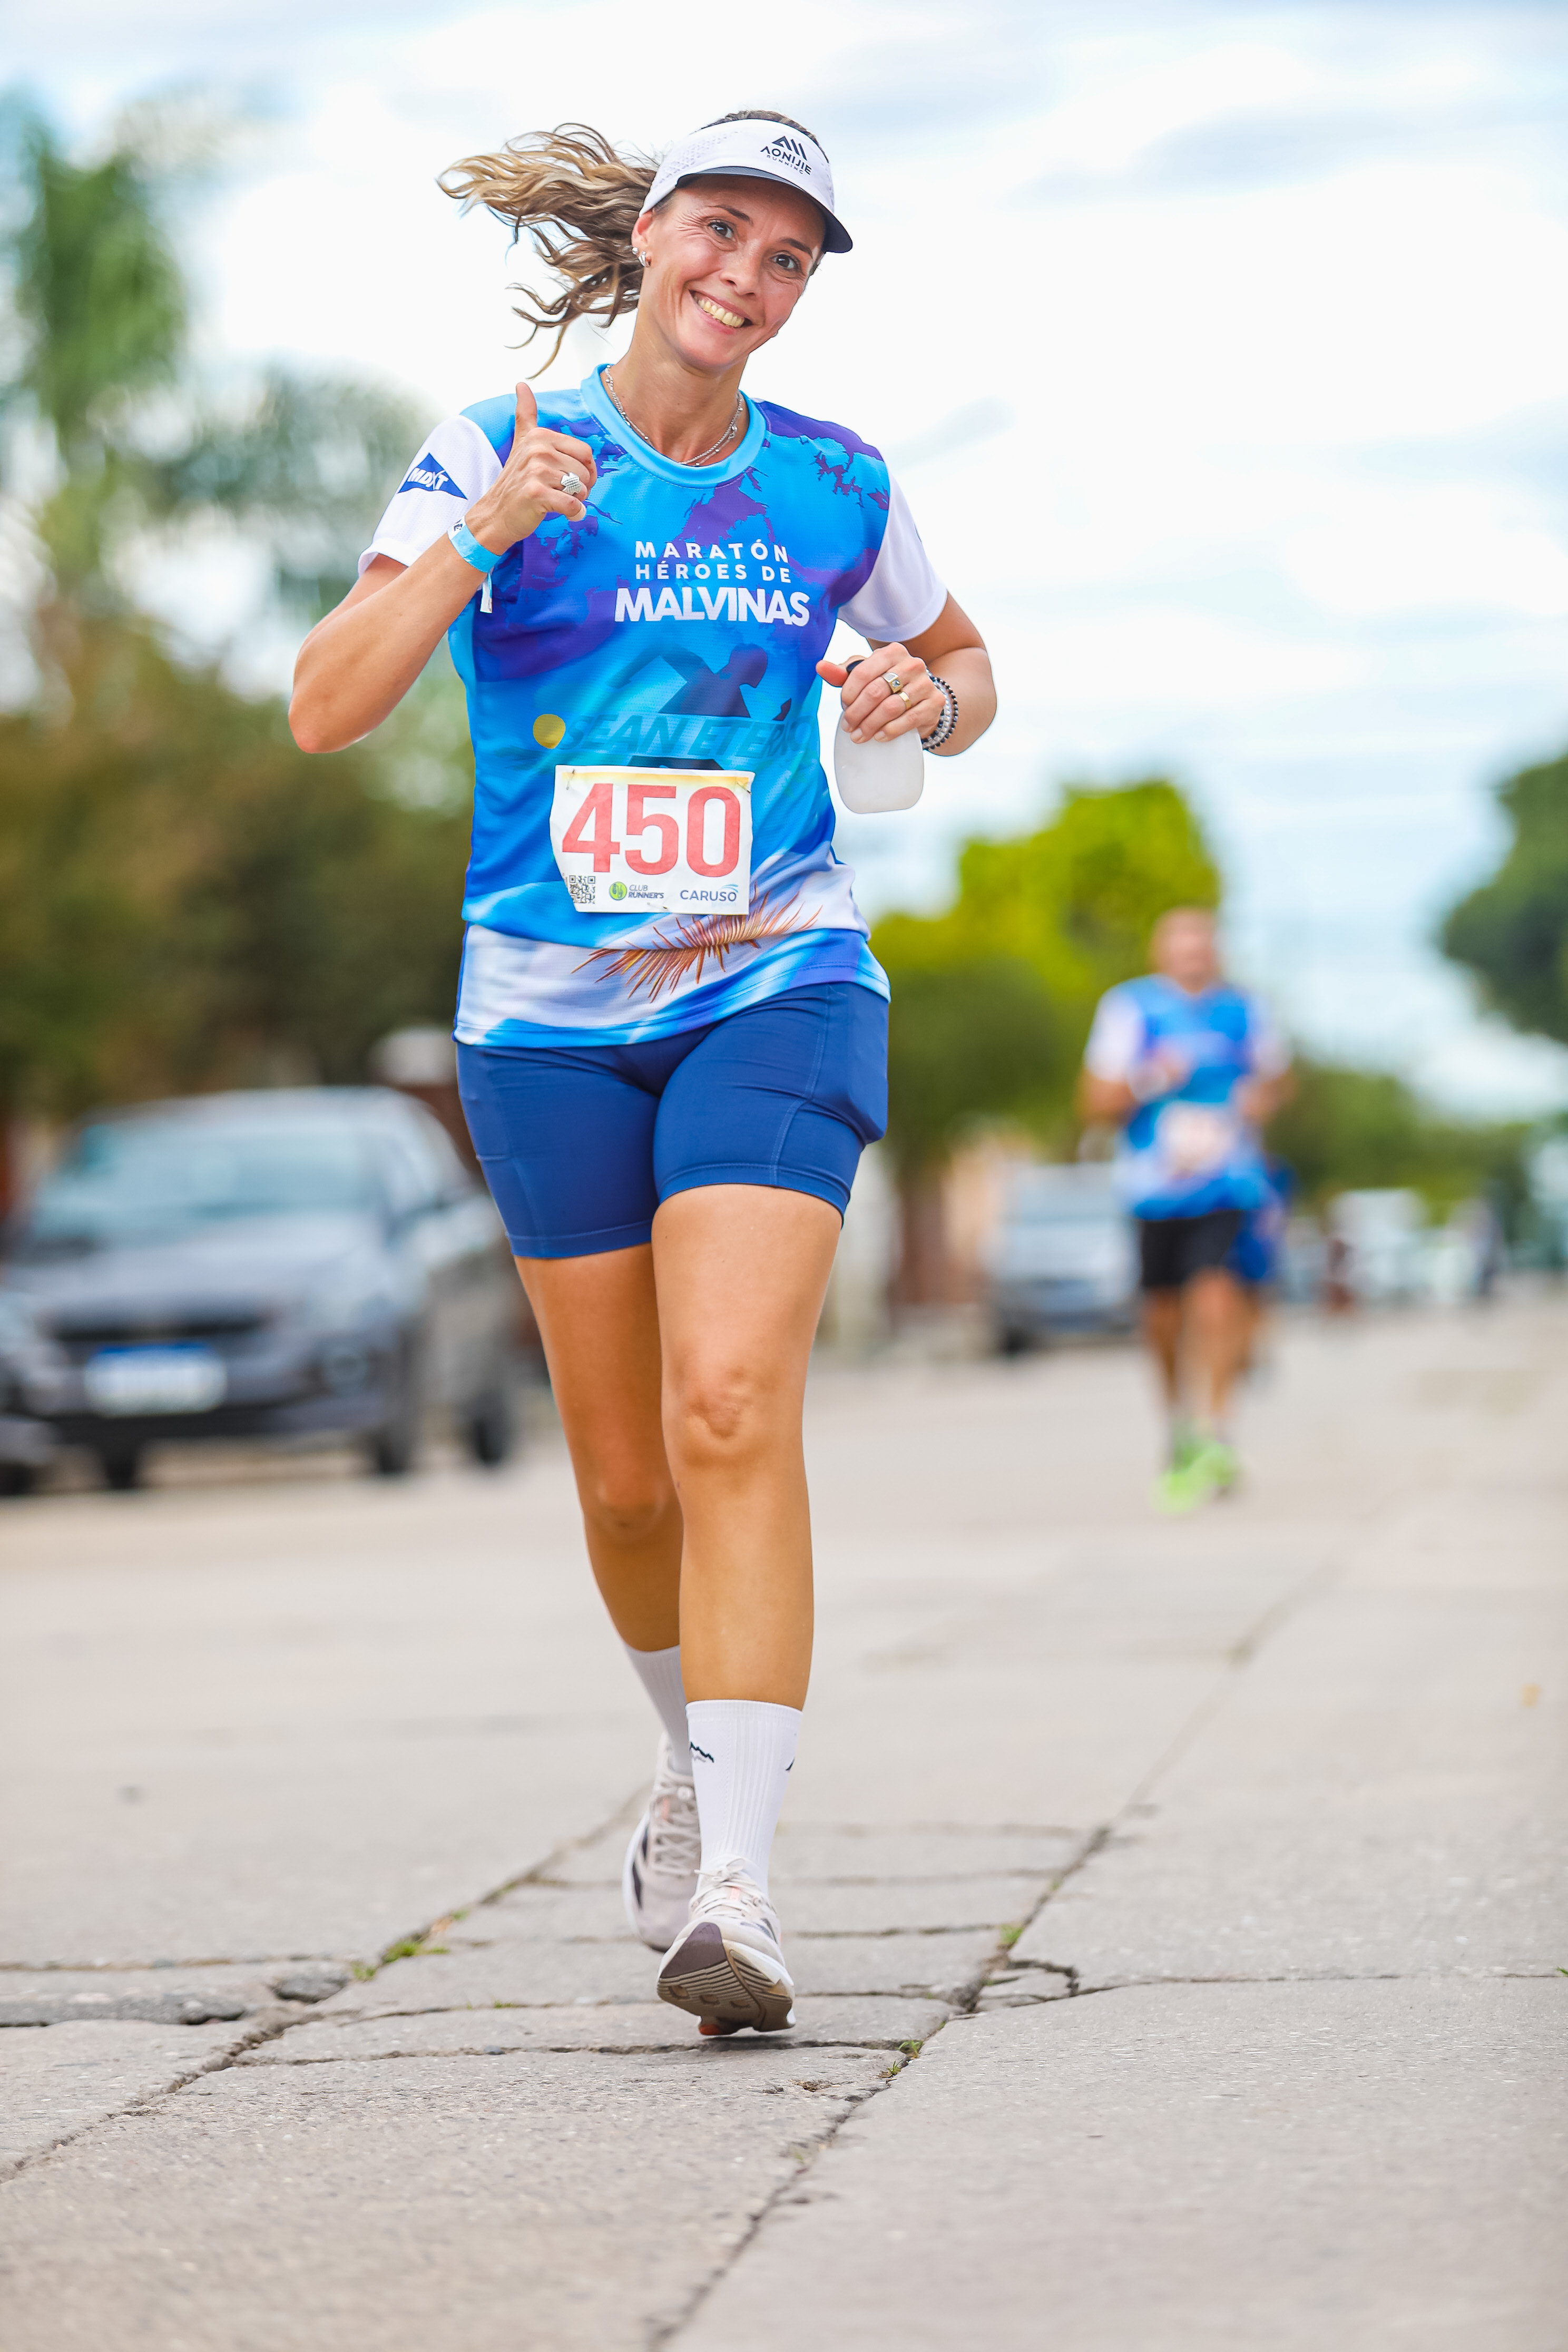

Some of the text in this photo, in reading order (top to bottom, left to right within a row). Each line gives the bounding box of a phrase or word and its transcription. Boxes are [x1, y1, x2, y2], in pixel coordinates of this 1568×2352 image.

[760, 146, 812, 175] AONIJIE
[635, 538, 789, 563] MARATÓN
[635, 561, 791, 584] HÉROES DE
[614, 586, 810, 627] MALVINAS
[562, 783, 740, 878] 450
[680, 890, 737, 902] CARUSO
